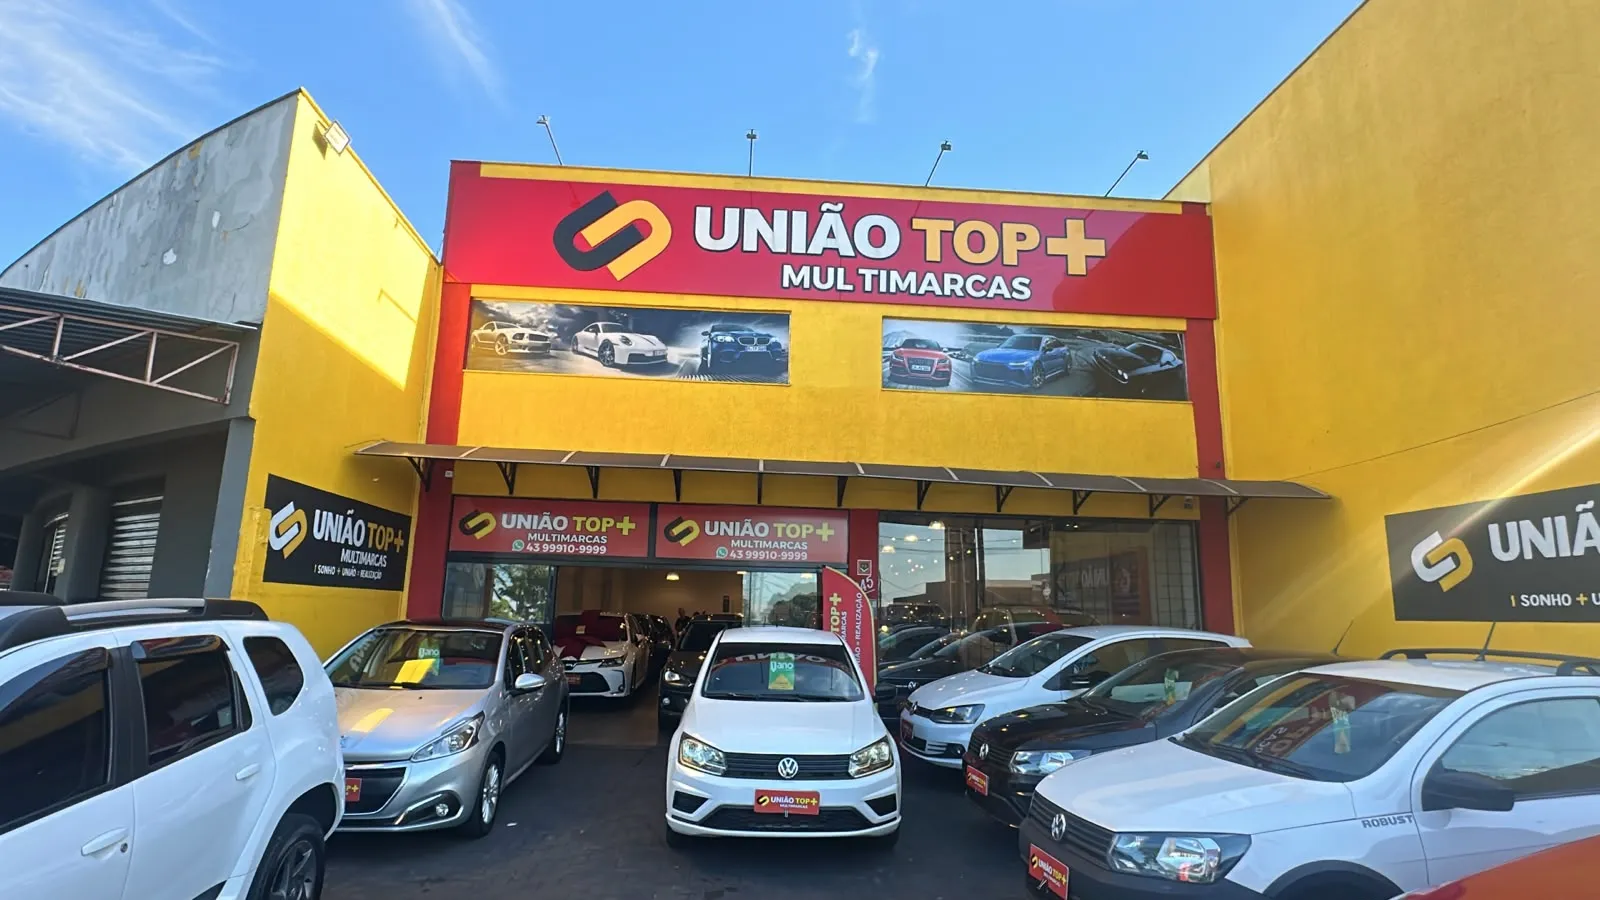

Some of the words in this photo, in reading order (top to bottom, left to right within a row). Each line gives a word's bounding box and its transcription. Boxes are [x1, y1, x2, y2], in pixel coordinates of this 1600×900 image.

[693, 202, 900, 260] UNIÃO
[312, 509, 366, 547] UNIÃO
[501, 512, 569, 531] UNIÃO
[704, 519, 770, 538] UNIÃO
[527, 533, 608, 544] MULTIMARCAS
[731, 539, 808, 550] MULTIMARCAS
[526, 543, 540, 552] 43
[542, 543, 607, 554] 99910-9999
[729, 550, 743, 559] 43
[745, 550, 808, 560] 99910-9999
[340, 548, 387, 568] MULTIMARCAS
[317, 564, 336, 575] SONHO
[1520, 593, 1572, 607] SONHO
[855, 592, 863, 640] REALIZAÇÃO
[770, 796, 795, 804] UNIÃO
[1361, 815, 1413, 828] ROBUST
